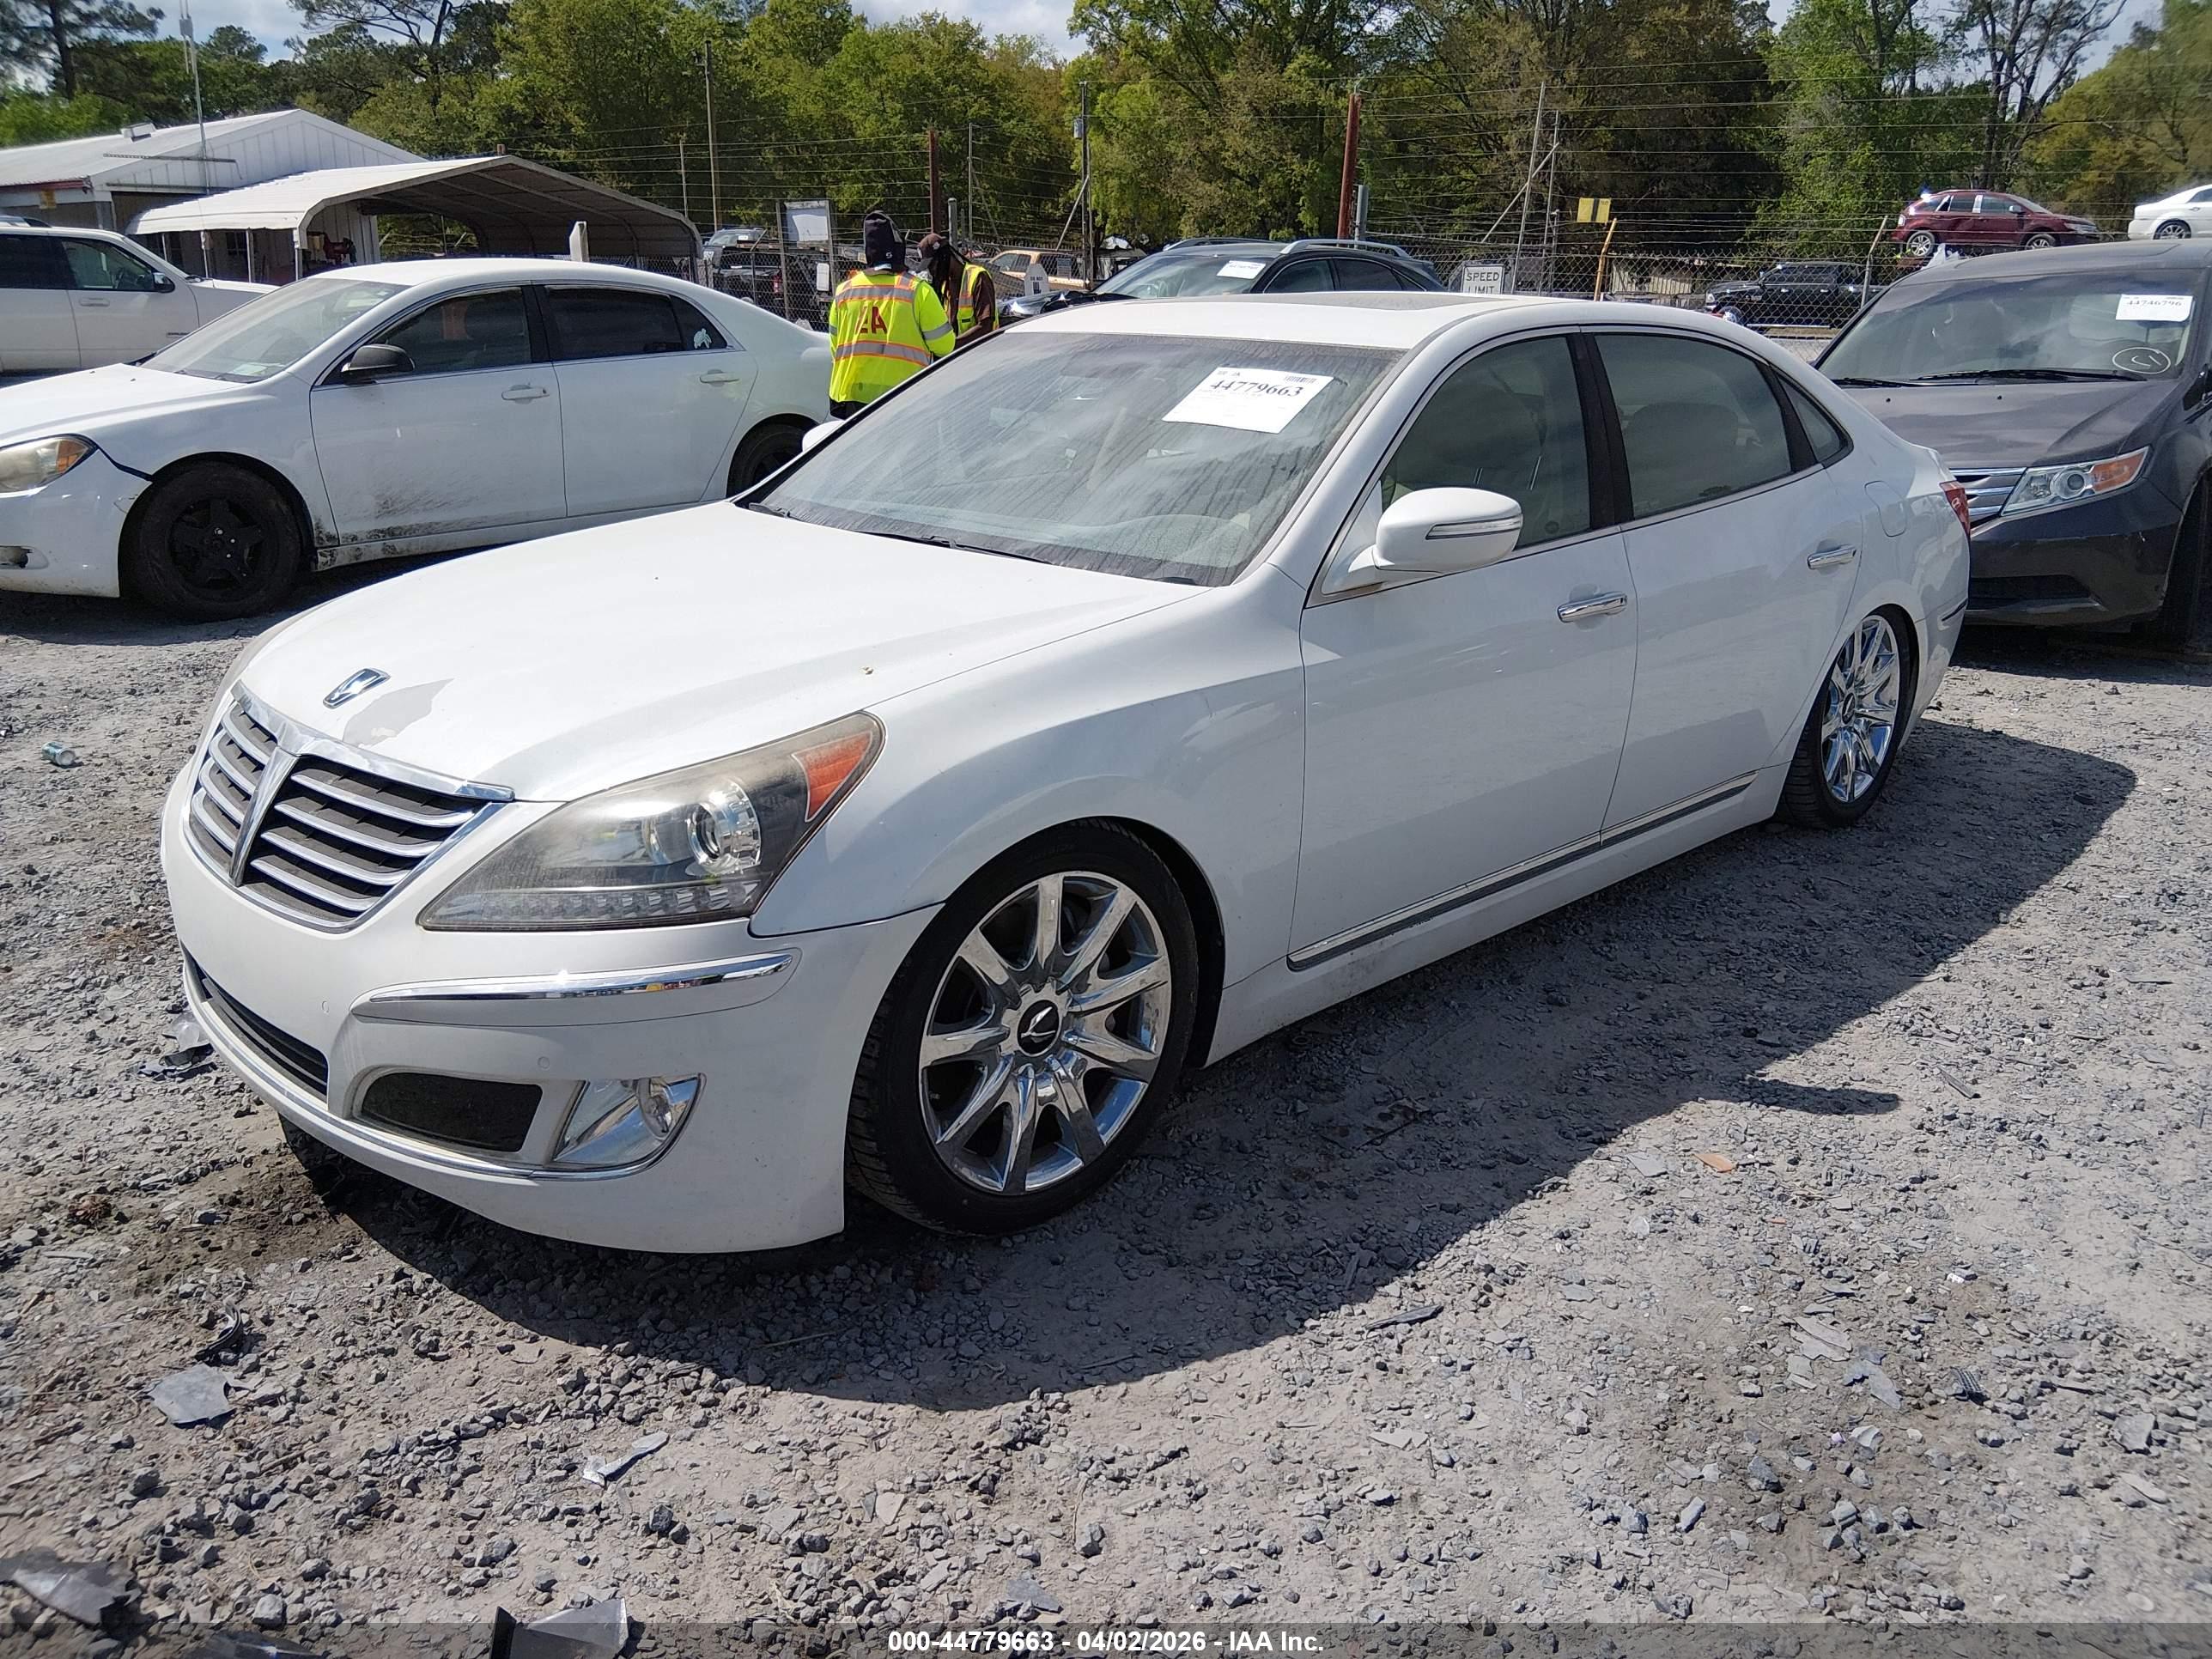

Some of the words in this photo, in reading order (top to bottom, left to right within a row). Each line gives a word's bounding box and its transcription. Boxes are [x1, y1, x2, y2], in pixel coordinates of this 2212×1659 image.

[1466, 271, 1500, 282] SPEED
[1468, 285, 1495, 295] LIMIT
[1209, 380, 1304, 398] 44779663
